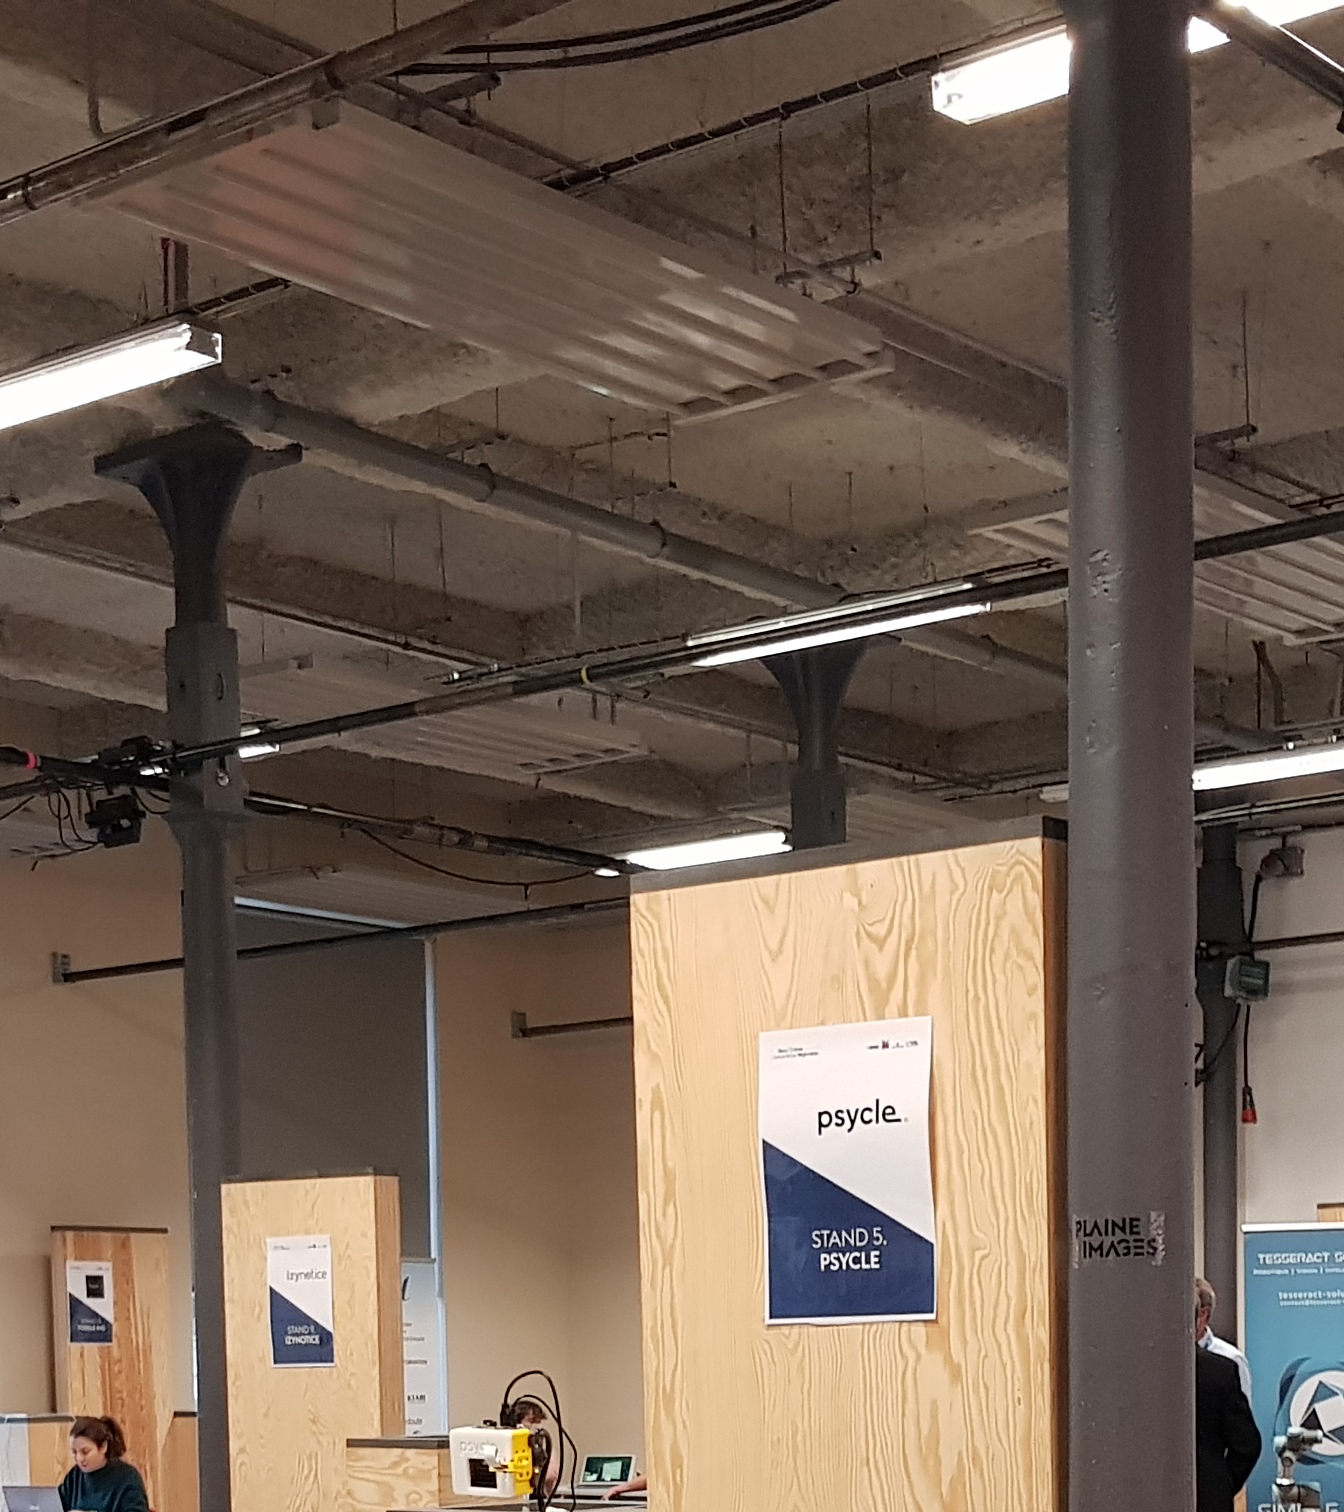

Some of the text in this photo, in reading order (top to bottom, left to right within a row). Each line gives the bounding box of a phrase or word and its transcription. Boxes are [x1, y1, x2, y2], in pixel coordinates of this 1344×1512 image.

[1076, 1218, 1141, 1237] PLAINE
[811, 1227, 887, 1249] STAND 5.
[1083, 1238, 1157, 1258] IMAGES
[1257, 1251, 1330, 1264] TESSERACT
[820, 1251, 880, 1271] PSYCLE
[287, 1325, 309, 1335] STAND
[285, 1335, 320, 1345] IZYNOTICE
